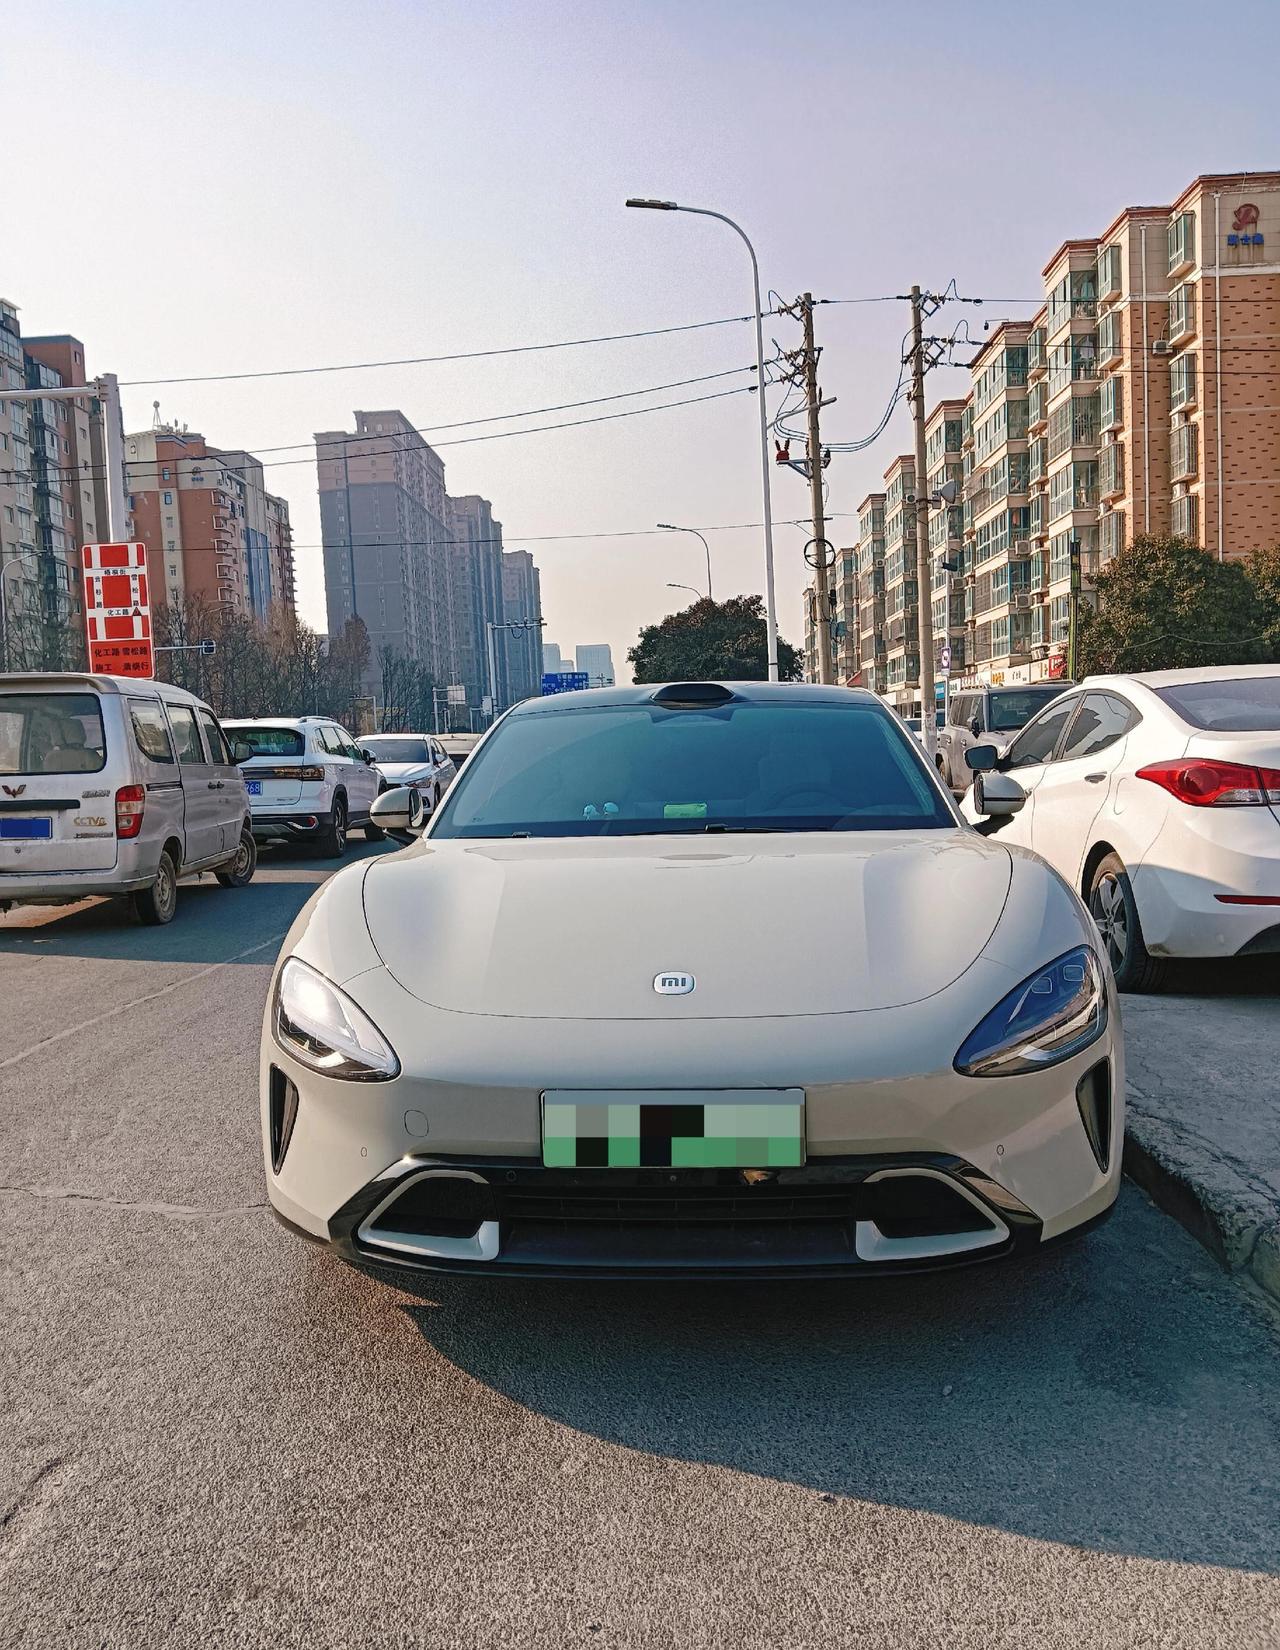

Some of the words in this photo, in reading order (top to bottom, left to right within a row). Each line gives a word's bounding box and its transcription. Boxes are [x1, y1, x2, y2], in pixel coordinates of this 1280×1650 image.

[107, 608, 129, 616] 化工路
[95, 647, 120, 657] 化工路
